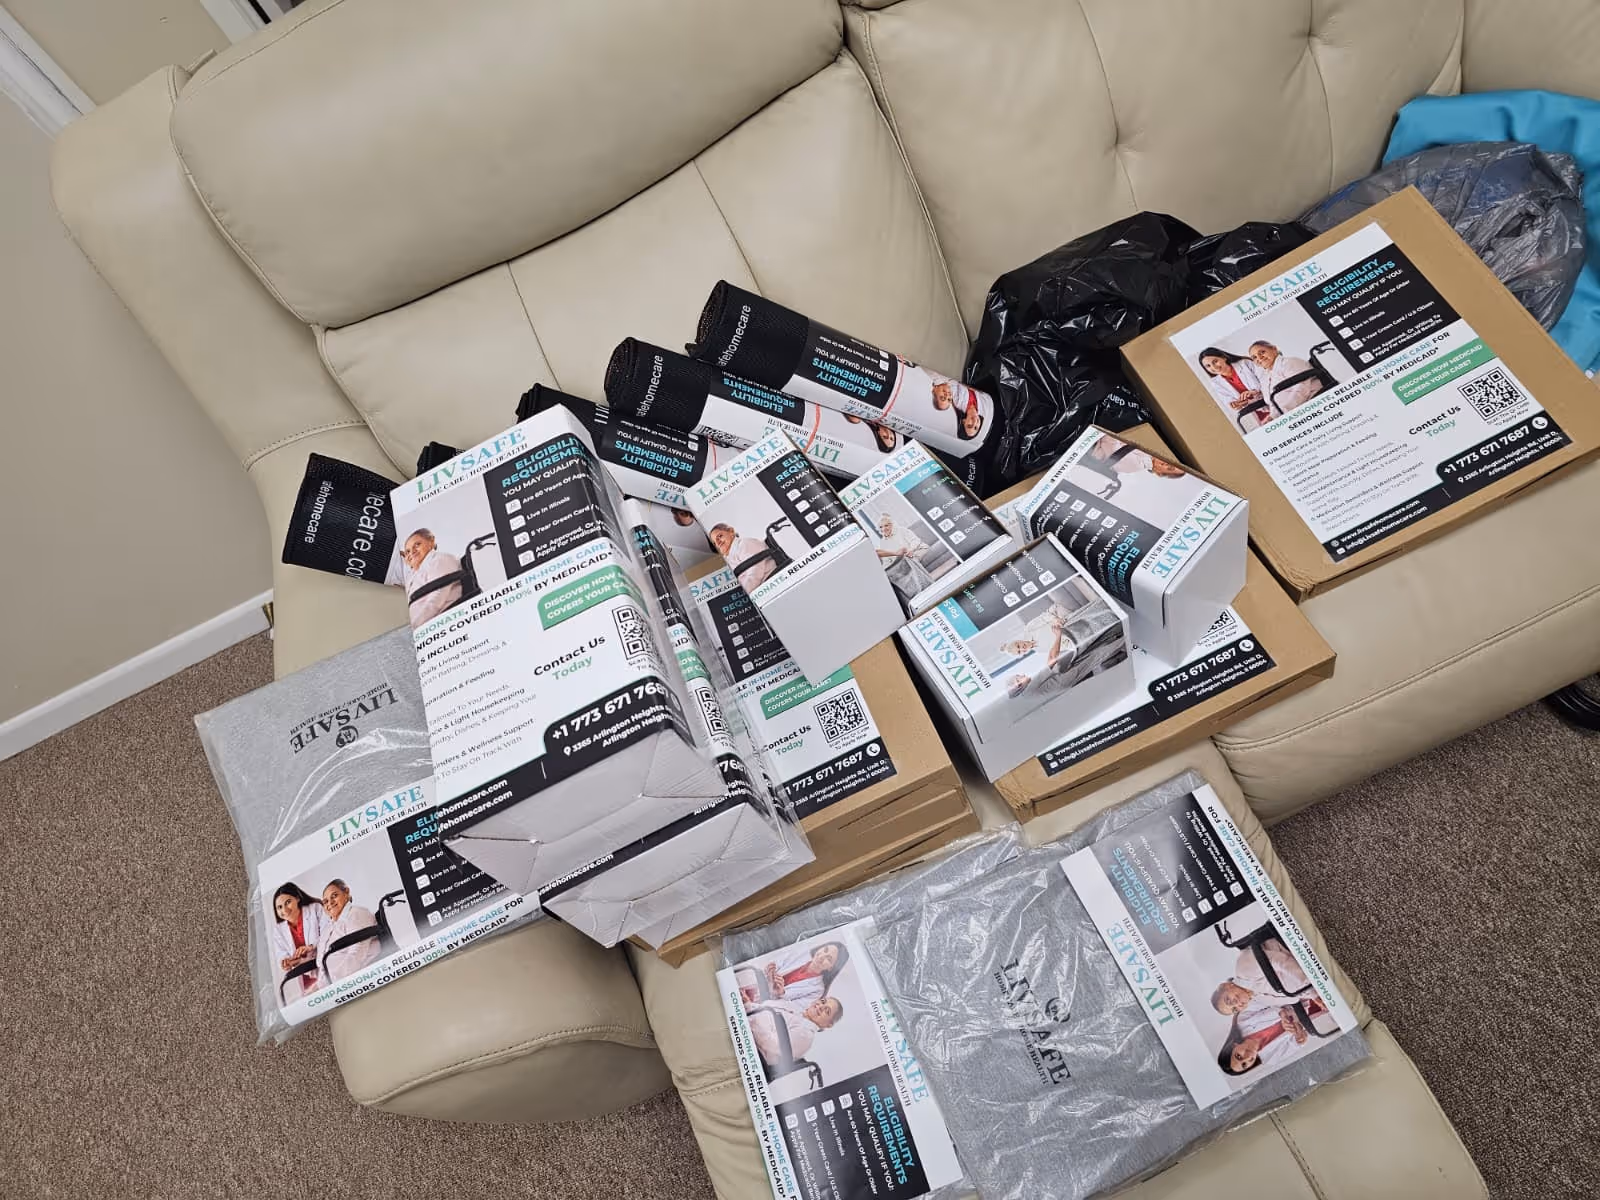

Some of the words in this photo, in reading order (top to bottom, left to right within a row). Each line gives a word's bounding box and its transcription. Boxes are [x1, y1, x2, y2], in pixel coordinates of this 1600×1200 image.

[1233, 260, 1324, 316] LIVSAFE
[1315, 260, 1397, 308] REQUIREMENTS
[1321, 258, 1381, 294] ELIGIBILITY
[1322, 305, 1337, 315] YOU
[1336, 297, 1352, 307] MAY
[1351, 281, 1380, 300] QUALIFY
[1386, 268, 1404, 280] YOU:
[809, 356, 884, 392] REQUIREMENTS
[814, 370, 869, 397] ELIGIBILITY
[860, 366, 873, 375] MAY
[873, 371, 887, 381] YOU
[1263, 392, 1335, 434] COMPASSIONATE,
[1332, 372, 1374, 397] RELIABLE
[1371, 353, 1410, 376] IN-HOME
[1407, 340, 1433, 356] CARE
[1431, 330, 1451, 344] FOR
[1397, 370, 1432, 392] DISCOVER
[1430, 361, 1450, 374] HOW
[1447, 343, 1483, 365] MEDICAID
[1403, 382, 1429, 398] COVERS
[1427, 370, 1451, 385] YOUR
[722, 377, 796, 407] REQUIREMENTS
[729, 388, 784, 413] ELIGIBILITY
[1287, 408, 1323, 431] SENIORS
[1322, 388, 1363, 412] COVERED
[1361, 377, 1383, 391] 100%
[1382, 369, 1397, 380] BY
[1261, 445, 1279, 458] OUR
[1277, 427, 1313, 449] SERVICES
[1311, 410, 1345, 431] INCLUDE
[1406, 411, 1449, 436] Contact
[1445, 404, 1462, 416] Us
[1424, 417, 1458, 439] Today
[416, 427, 527, 494] LIVSAFE
[499, 443, 582, 490] REQUIREME
[513, 433, 578, 471] ELIGIBILI
[613, 439, 693, 472] REQUIREMENTS
[620, 452, 678, 477] ELIGIBILITY
[696, 433, 784, 501] LIVSAFE
[1440, 462, 1457, 475] +1
[1454, 451, 1481, 468] 773
[1477, 440, 1501, 457] 671
[1497, 424, 1532, 446] 7687
[1476, 456, 1507, 474] Arlington
[1503, 444, 1529, 460] Heights
[1486, 459, 1516, 477] Arlington
[502, 484, 522, 497] YOU
[522, 475, 542, 488] MAY
[542, 457, 581, 479] QUALIFY
[840, 445, 923, 505] LIVSAFE
[526, 509, 541, 520] Live
[540, 505, 549, 513] In
[548, 495, 570, 510] Illinois
[535, 522, 552, 534] Year
[551, 512, 573, 526] Green
[573, 504, 590, 516] Card
[1148, 492, 1230, 582] LIVSAFE
[785, 545, 828, 576] RELIABLE
[412, 607, 470, 641] SSIONATE,
[468, 579, 523, 611] RELIABLE
[523, 555, 575, 585] IN-HOME
[574, 540, 607, 561] CARE
[543, 583, 590, 610] DISCOVER
[590, 570, 616, 588] HOW
[545, 596, 584, 619] COVERS
[584, 583, 613, 601] YOUR
[413, 628, 447, 651] NIORS
[447, 601, 503, 633] COVERED
[502, 586, 533, 607] 100%
[533, 578, 549, 591] BY
[425, 633, 470, 659] INCLUDE
[531, 644, 586, 676] Contact
[587, 634, 606, 649] Us
[914, 615, 983, 700] LIVSAFE
[551, 654, 595, 682] Today
[1153, 680, 1168, 694] +1
[1166, 670, 1190, 688] 773
[1187, 660, 1209, 677] 671
[1206, 646, 1238, 668] 7687
[289, 686, 399, 755] LIVSAFE
[470, 687, 526, 717] Housekeeping
[550, 723, 570, 741] +1
[569, 706, 603, 731] 773
[602, 692, 633, 715] 671
[632, 677, 667, 705] 768
[502, 717, 534, 738] Support
[570, 737, 592, 752] 3365
[590, 717, 632, 743] Arlington
[630, 702, 664, 724] Heights
[600, 722, 642, 748] Arlington
[774, 736, 806, 757] Today
[797, 723, 812, 735] Us
[790, 774, 815, 792] 773
[813, 764, 834, 781] 671
[833, 750, 865, 772] 7687
[323, 784, 426, 843] LIVSAFE
[1206, 804, 1222, 824] FOR
[406, 843, 424, 855] YOU
[1217, 822, 1236, 848] CARE
[1232, 846, 1260, 887] IN-HOME
[1109, 860, 1152, 927] ELIGIBILITY
[1112, 843, 1170, 936] REQUIREMENTS
[1254, 883, 1286, 930] RELIABLE
[305, 961, 392, 1009] COMPASSIONATE,
[390, 940, 436, 967] RELIABLE
[435, 919, 478, 945] IN-HOME
[477, 906, 504, 924] CARE
[502, 895, 524, 911] FOR
[334, 980, 377, 1006] SENIORS
[375, 959, 421, 986] COVERED
[421, 946, 447, 964] 100%
[446, 939, 461, 951] BY
[1105, 919, 1175, 1028] LIVSAFE
[727, 990, 760, 1073] COMPASSIONATE,
[752, 1074, 773, 1120] RELIABLE
[854, 1088, 867, 1107] YOU
[861, 1107, 874, 1125] MAY
[863, 1084, 910, 1185] REQUIREMENTS
[866, 1125, 886, 1160] QUALIFY
[881, 1095, 916, 1169] ELIGIBILITY
[879, 1160, 888, 1169] IF
